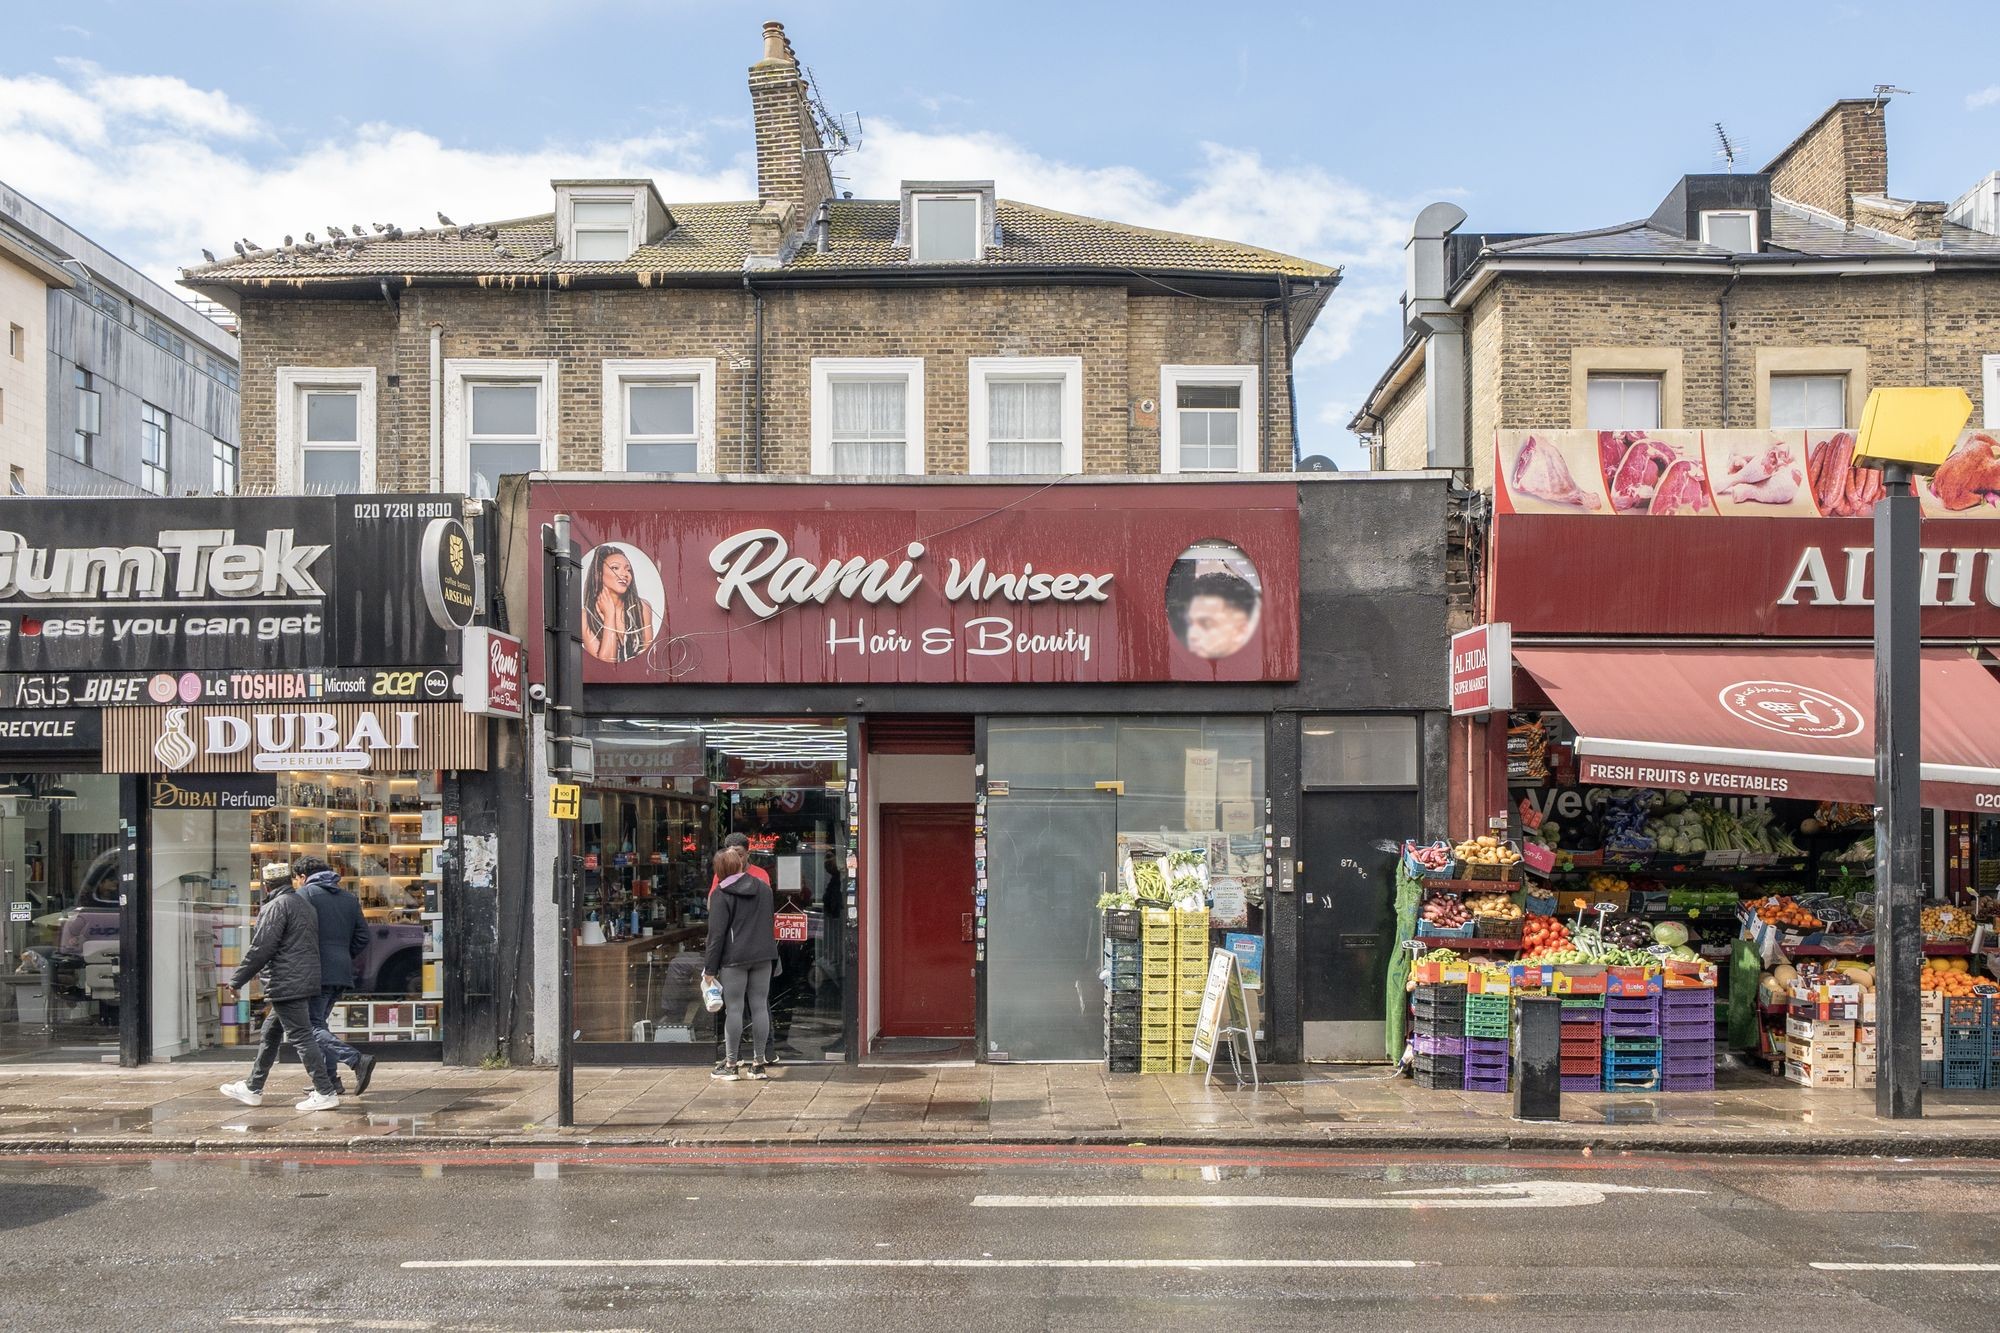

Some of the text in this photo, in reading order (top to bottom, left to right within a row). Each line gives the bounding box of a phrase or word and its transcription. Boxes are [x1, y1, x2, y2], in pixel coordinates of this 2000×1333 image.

[354, 503, 452, 519] 020 7281 8800
[709, 528, 1114, 618] Rami Unisex
[445, 587, 472, 607] ARSELAN
[19, 615, 105, 637] best
[113, 618, 178, 641] you
[184, 617, 250, 637] can
[257, 614, 322, 639] get
[826, 616, 1091, 661] Hair & Beauty
[490, 639, 518, 679] Rami
[1454, 648, 1488, 674] AL HUDA
[16, 676, 70, 706] ASUS
[74, 678, 148, 702] BOSE
[205, 680, 227, 696] LG
[230, 674, 307, 700] TOSHIBA
[324, 677, 366, 693] Microsoft
[372, 671, 423, 696] acer
[427, 679, 446, 687] DELL
[1454, 676, 1488, 695] SUPER MARKET
[0, 721, 76, 737] RECYCLE
[203, 711, 420, 755] DUBAI
[280, 756, 342, 766] PERFUME
[1590, 764, 1789, 793] FRESH FRUITS & VEGETABLES
[151, 781, 276, 808] DUBAI Perfume
[12, 913, 30, 921] PUSH
[780, 927, 802, 939] OPEN
